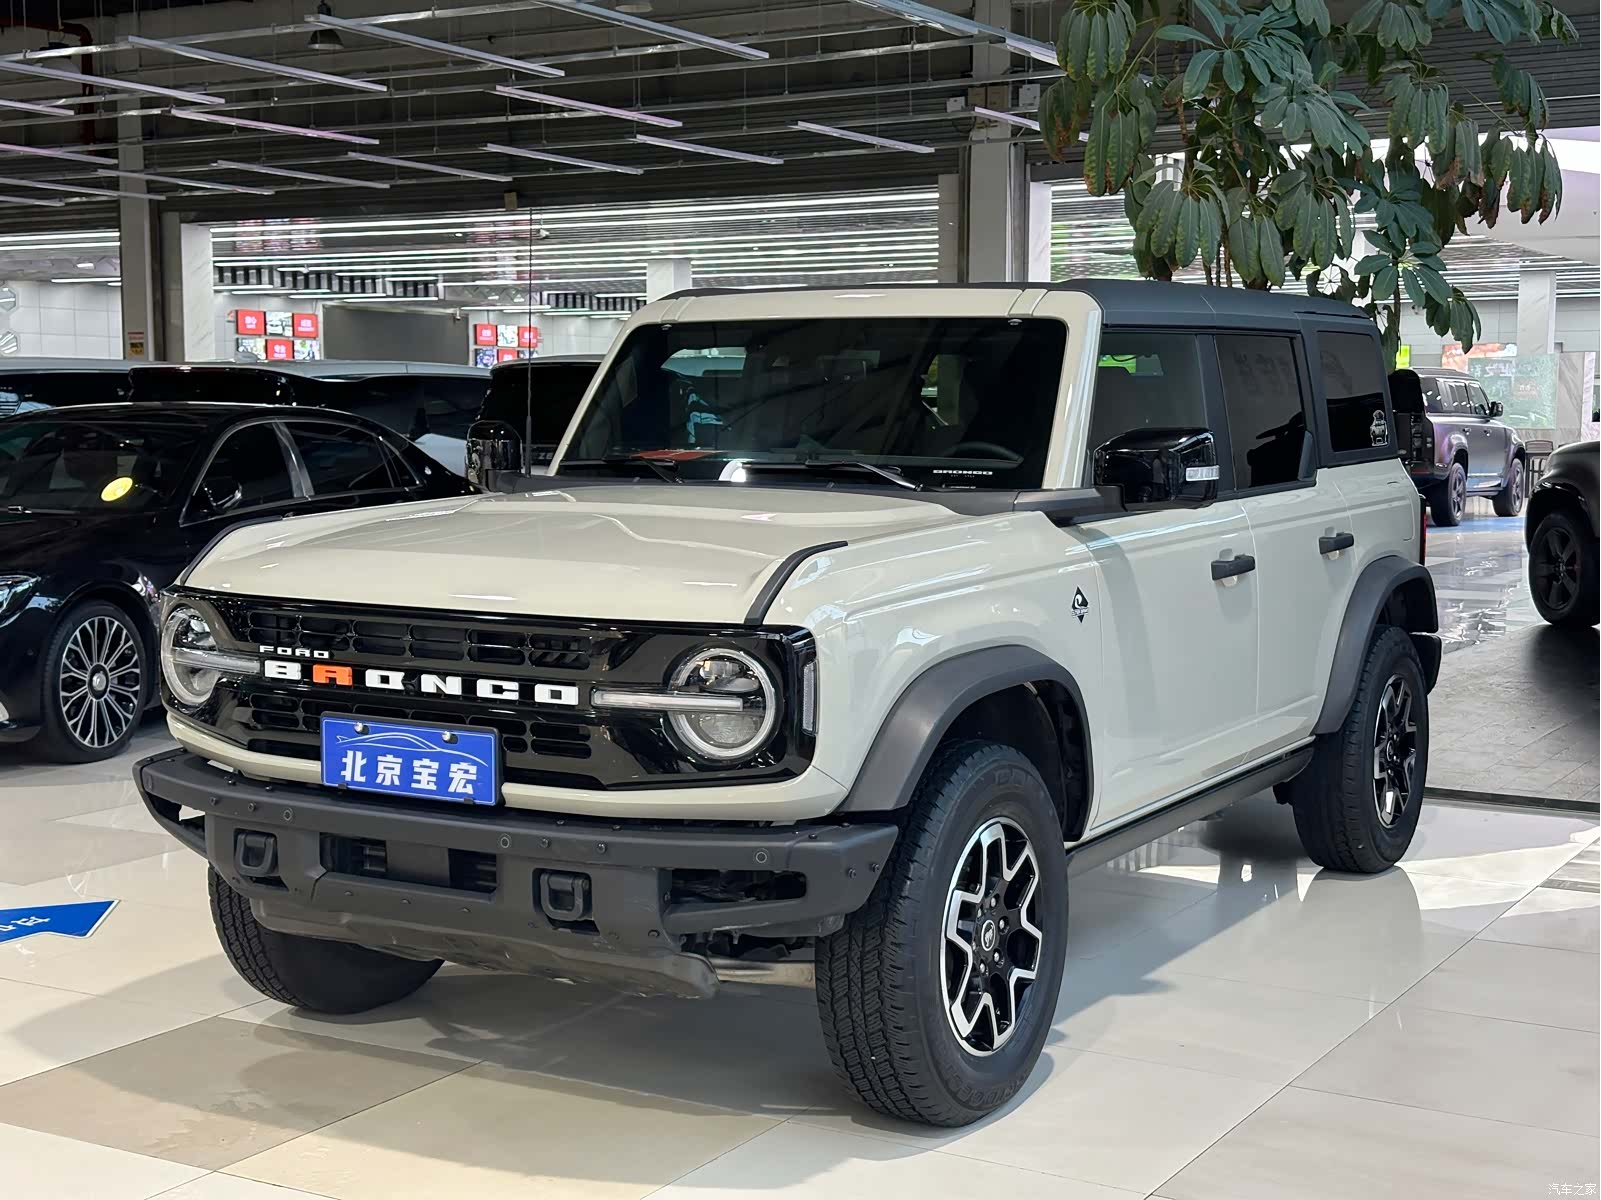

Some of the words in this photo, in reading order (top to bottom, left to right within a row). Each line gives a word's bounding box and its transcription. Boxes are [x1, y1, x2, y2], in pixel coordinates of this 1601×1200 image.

[259, 645, 329, 659] FORD
[264, 659, 579, 706] BRONCO
[340, 750, 479, 794] 北京宝宏
